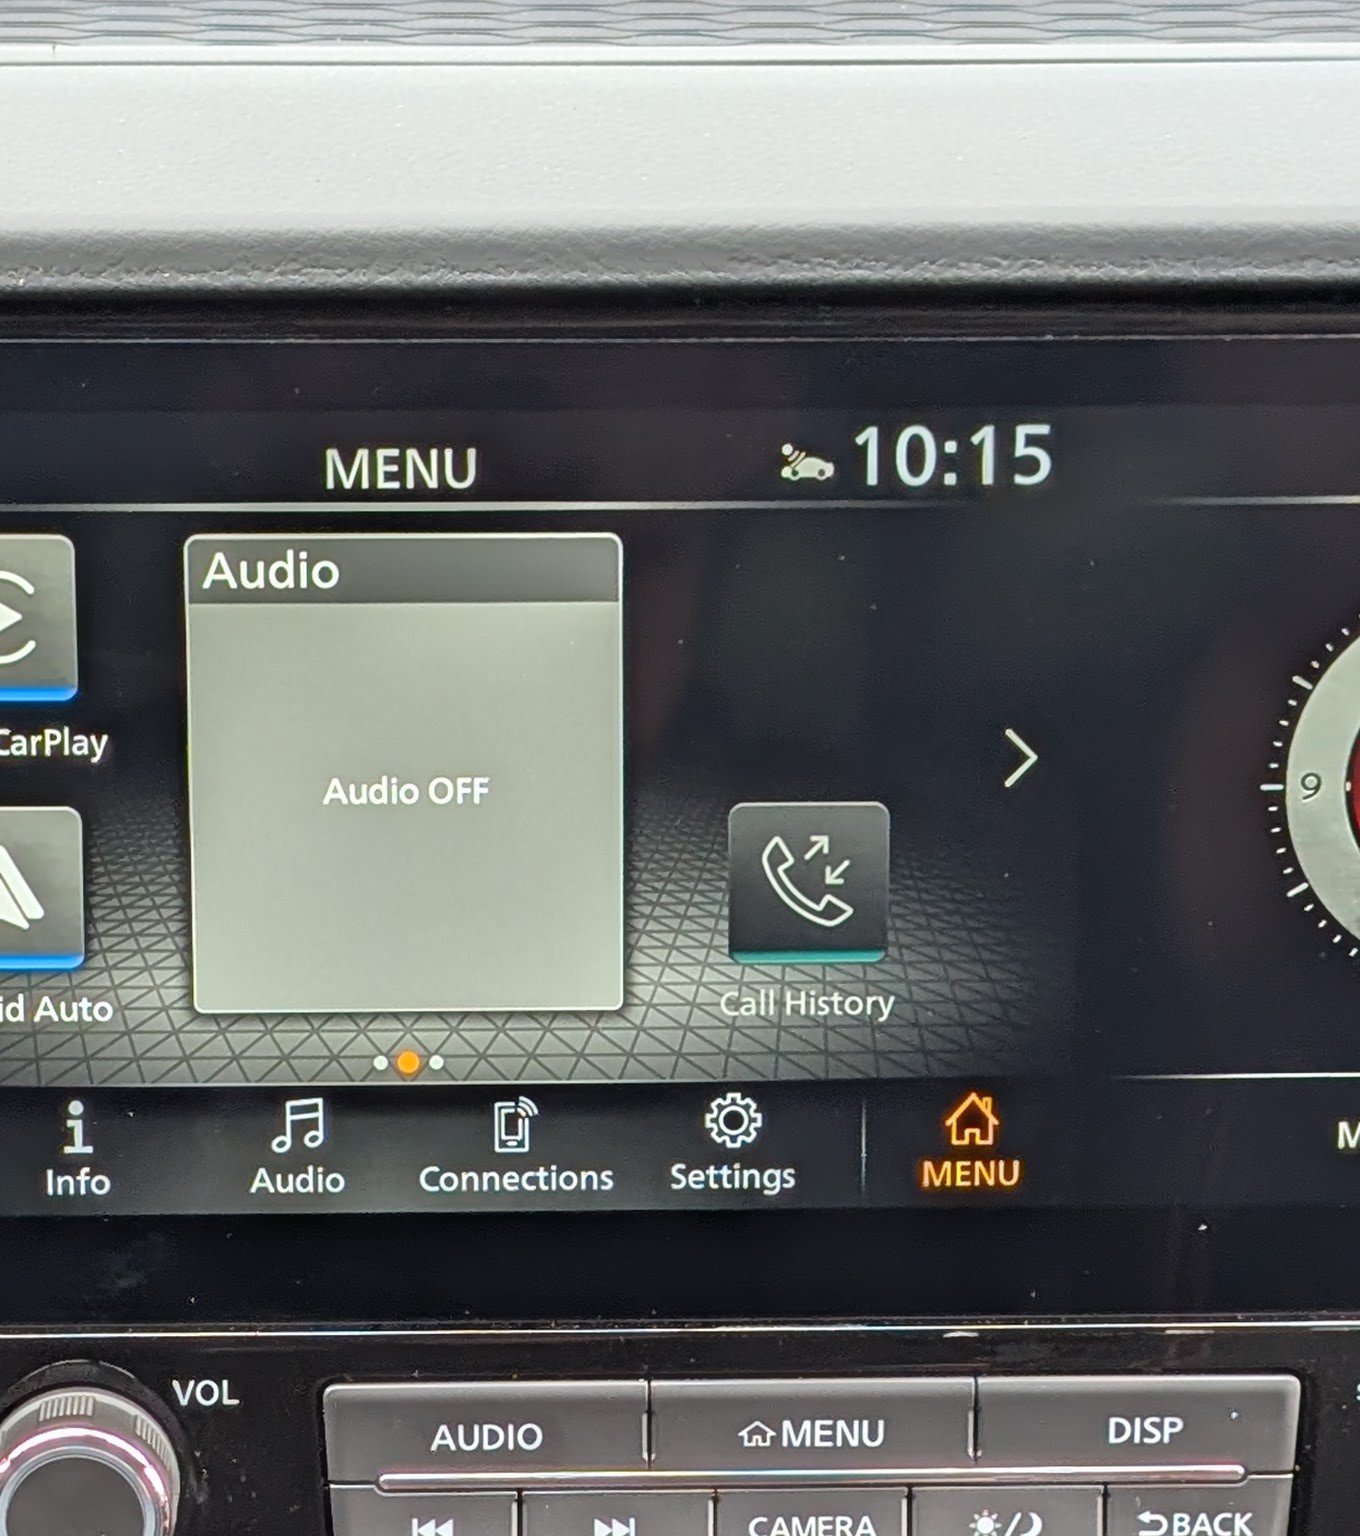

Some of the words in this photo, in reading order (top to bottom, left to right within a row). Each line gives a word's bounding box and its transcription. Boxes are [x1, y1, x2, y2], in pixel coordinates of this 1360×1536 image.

[324, 447, 479, 491] MENU
[852, 423, 1056, 489] 10:15
[201, 548, 340, 590] Audio
[323, 776, 421, 805] Audio
[427, 776, 491, 805] OFF
[1300, 772, 1323, 801] 9
[33, 994, 115, 1024] Auto
[719, 989, 776, 1016] Call
[784, 990, 896, 1021] History
[45, 1167, 112, 1197] Info
[250, 1165, 347, 1195] Audio
[419, 1163, 615, 1194] Connections
[670, 1162, 797, 1196] Settings
[922, 1160, 1022, 1190] MENU
[172, 1380, 240, 1407] VOL
[430, 1424, 544, 1452] AUDIO
[782, 1420, 886, 1448] MENU
[1107, 1416, 1185, 1445] DISP
